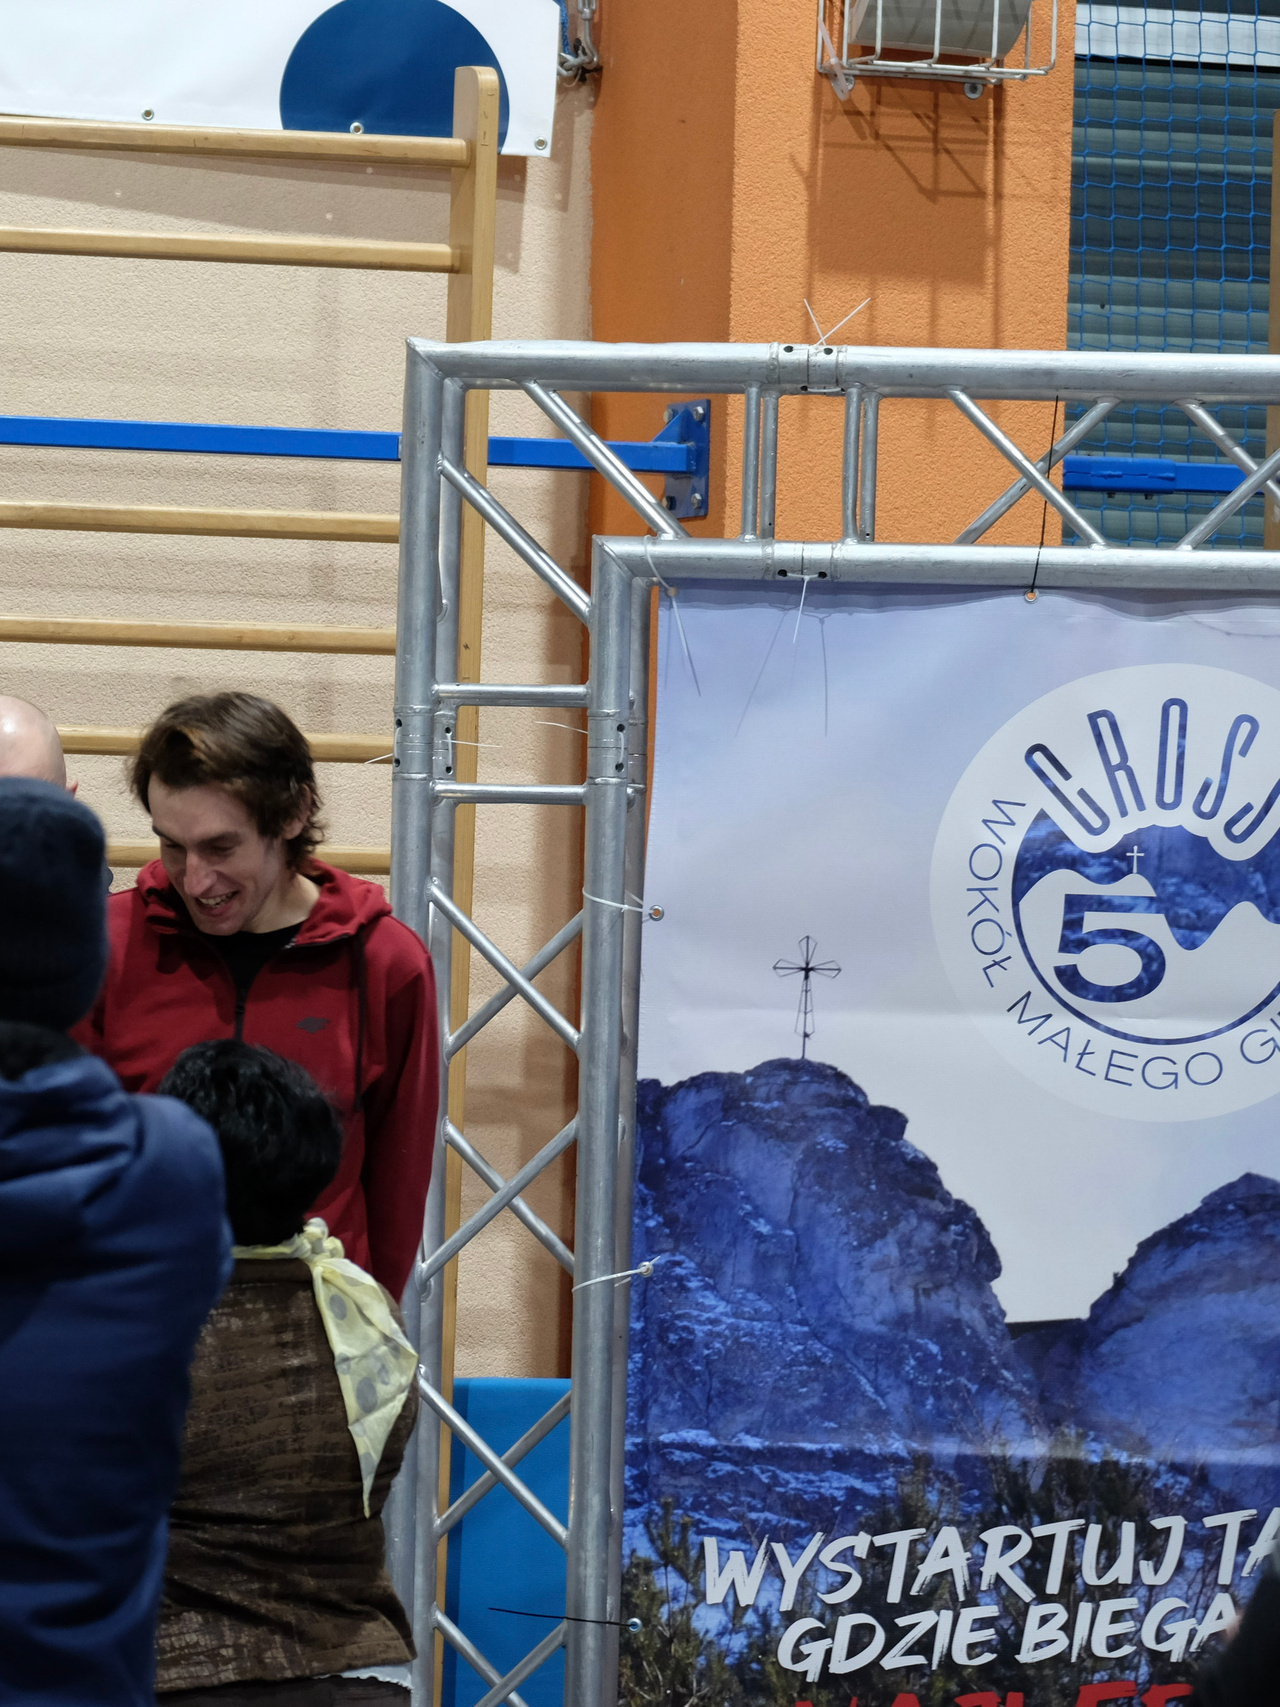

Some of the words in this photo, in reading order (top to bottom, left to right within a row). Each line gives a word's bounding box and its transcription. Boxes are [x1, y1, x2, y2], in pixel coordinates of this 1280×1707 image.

[966, 798, 1027, 988] WOKÓŁ
[1053, 893, 1167, 1003] 5
[1006, 990, 1224, 1090] MAŁEGO
[704, 1515, 1188, 1611] WYSTARTUJ
[777, 1604, 1000, 1683] GDZIE
[1015, 1592, 1237, 1663] BIEGA
